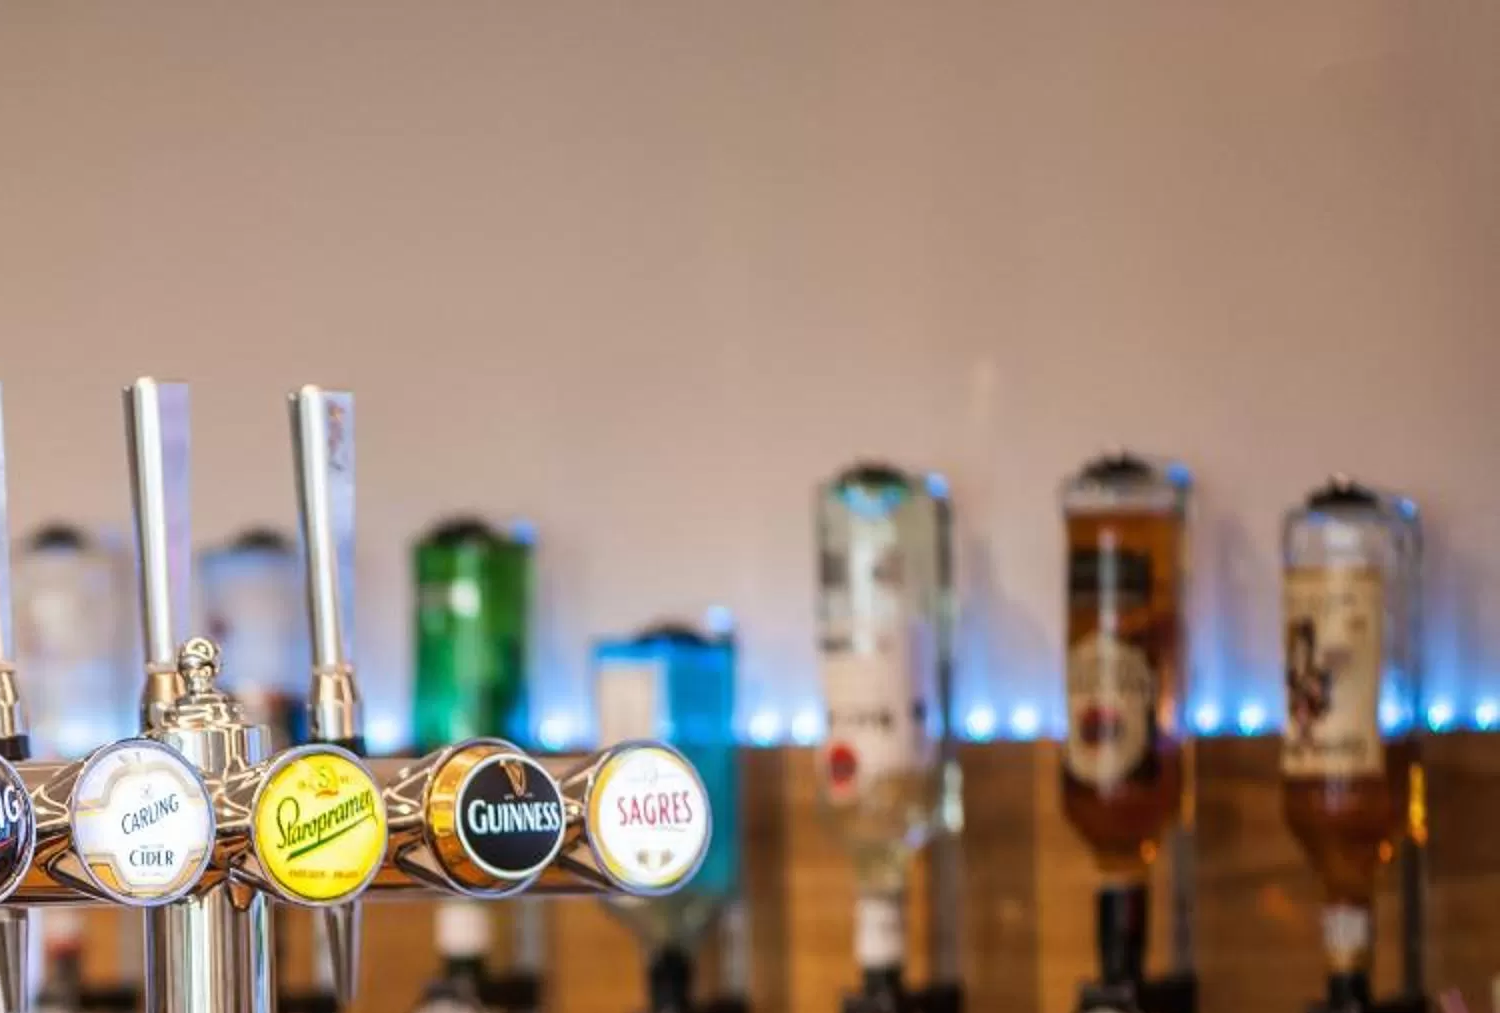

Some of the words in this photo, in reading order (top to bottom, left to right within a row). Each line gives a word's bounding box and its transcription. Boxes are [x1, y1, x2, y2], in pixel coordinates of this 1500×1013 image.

[121, 793, 179, 835] CARLING
[276, 788, 376, 849] Staropramen
[467, 799, 560, 835] GUINNESS
[617, 789, 693, 827] SAGRES
[129, 849, 175, 867] CIDER
